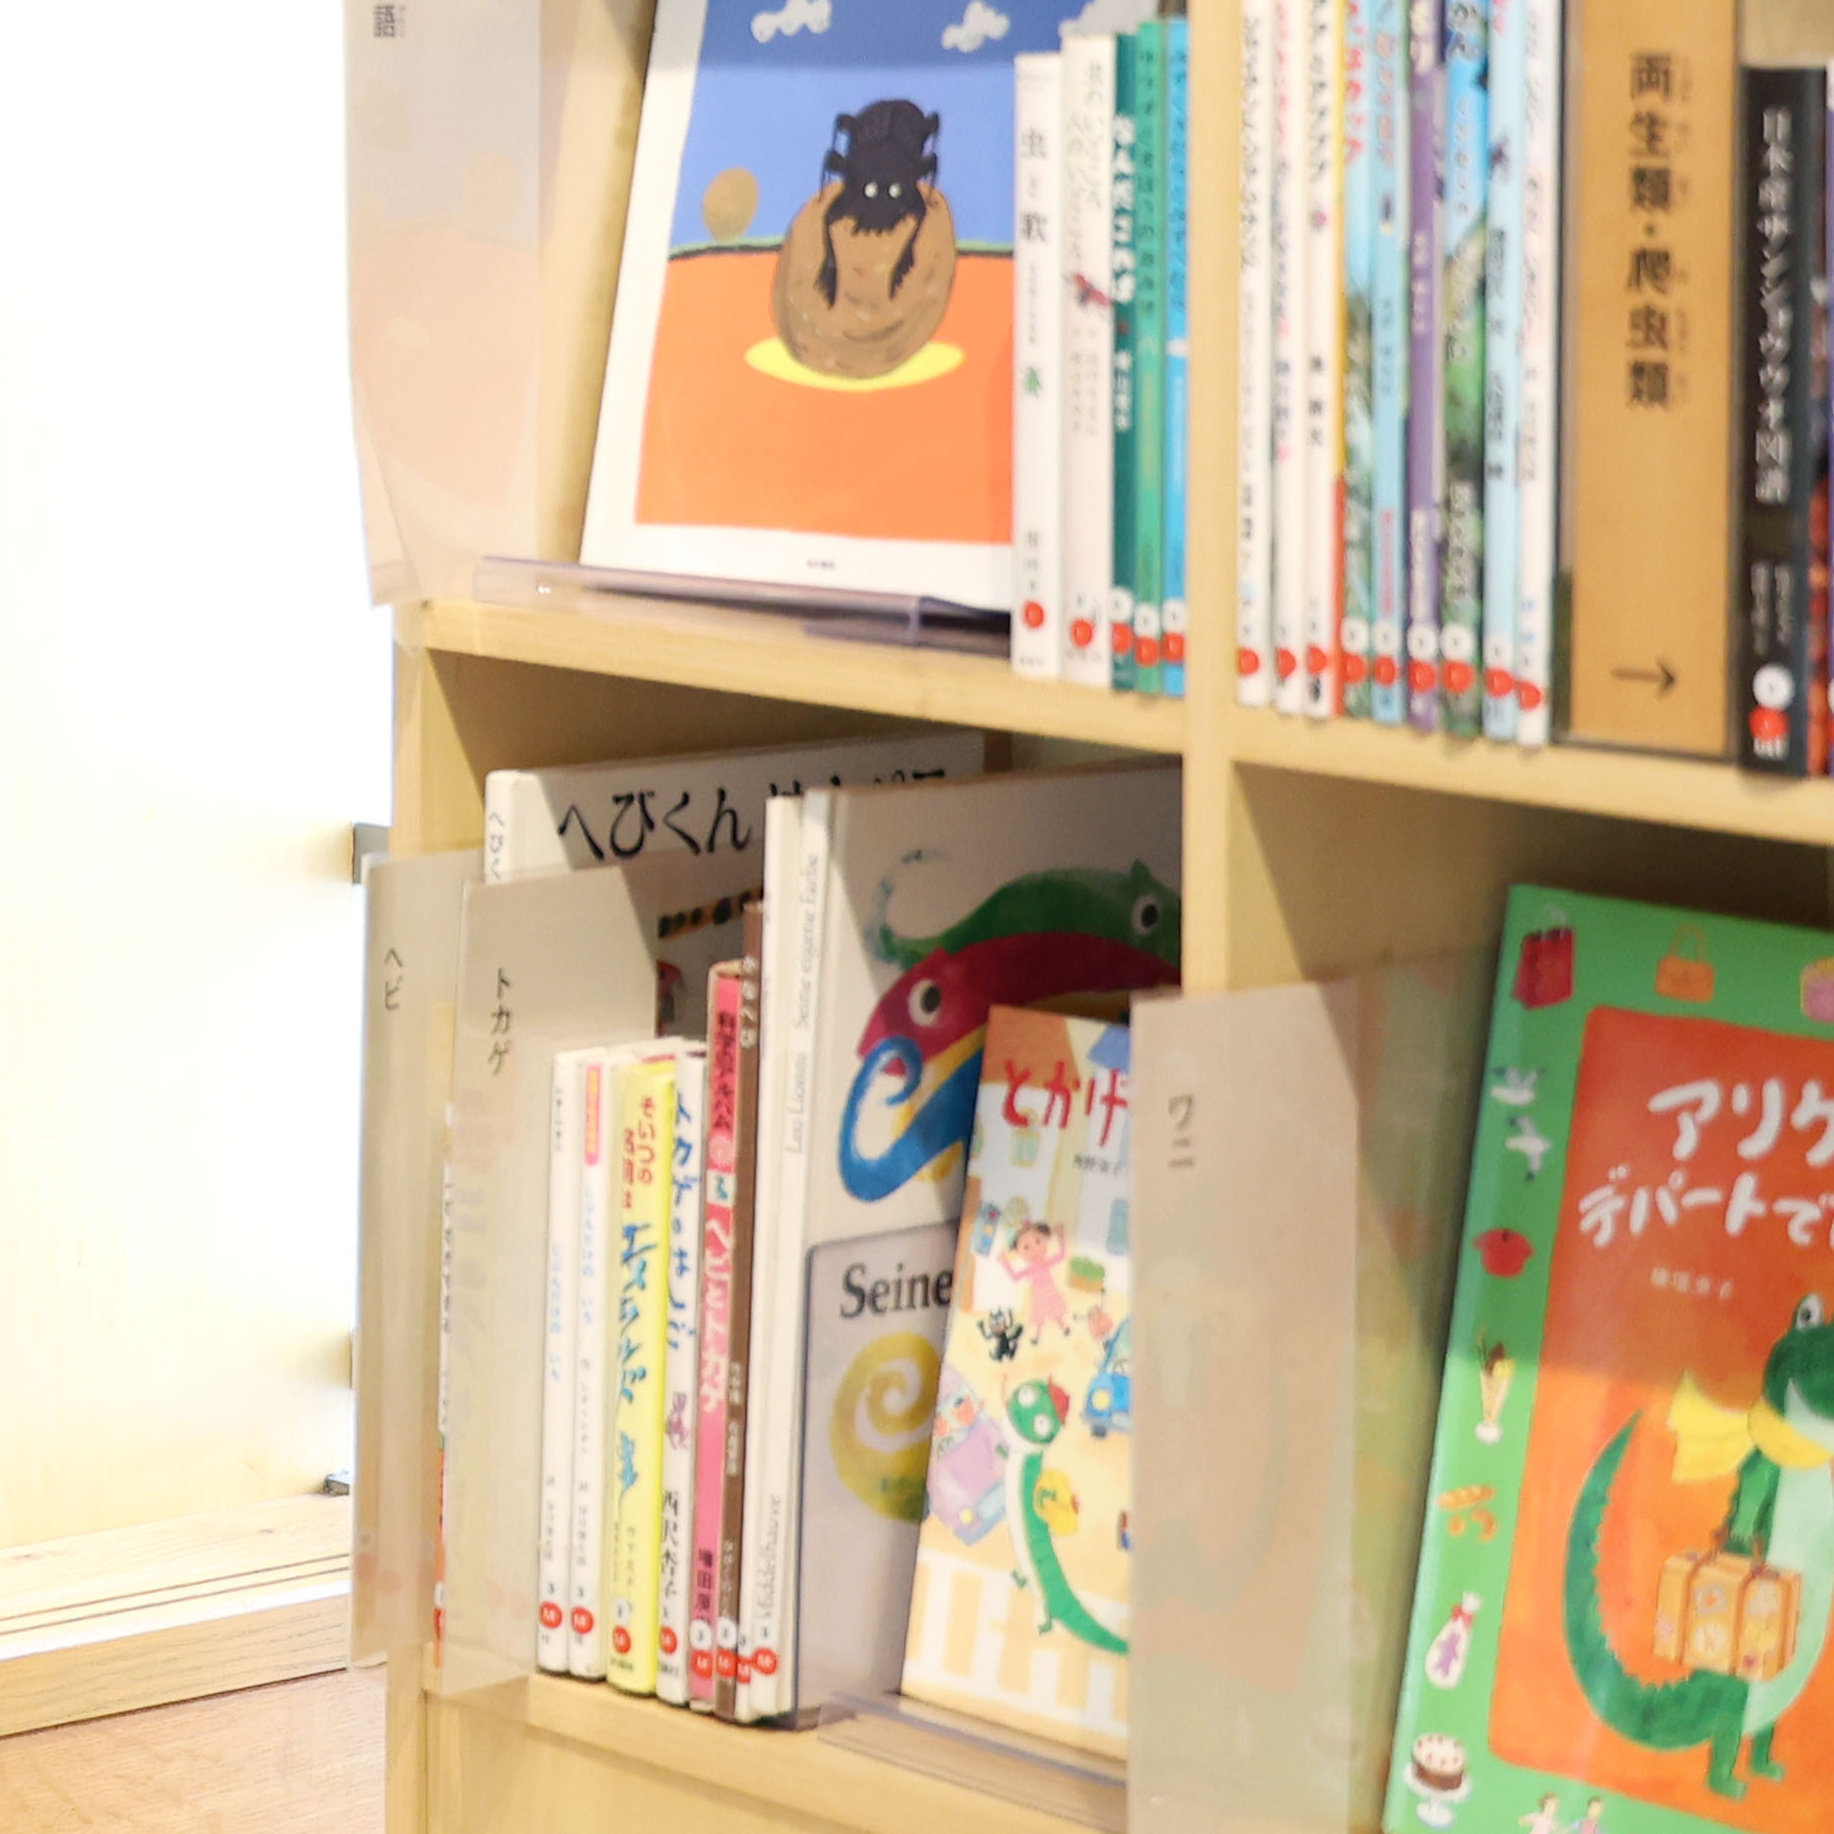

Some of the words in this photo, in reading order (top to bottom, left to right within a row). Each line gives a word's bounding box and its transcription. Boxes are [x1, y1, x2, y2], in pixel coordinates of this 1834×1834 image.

[1630, 55, 1673, 408] 両生類・爬虫類
[557, 787, 750, 861] へびくん
[384, 948, 402, 1011] ヘビ
[488, 967, 511, 1076] トカゲ
[1168, 1093, 1194, 1168] ワニ
[1578, 1163, 1834, 1249] デパートで
[840, 1262, 952, 1320] Seine
